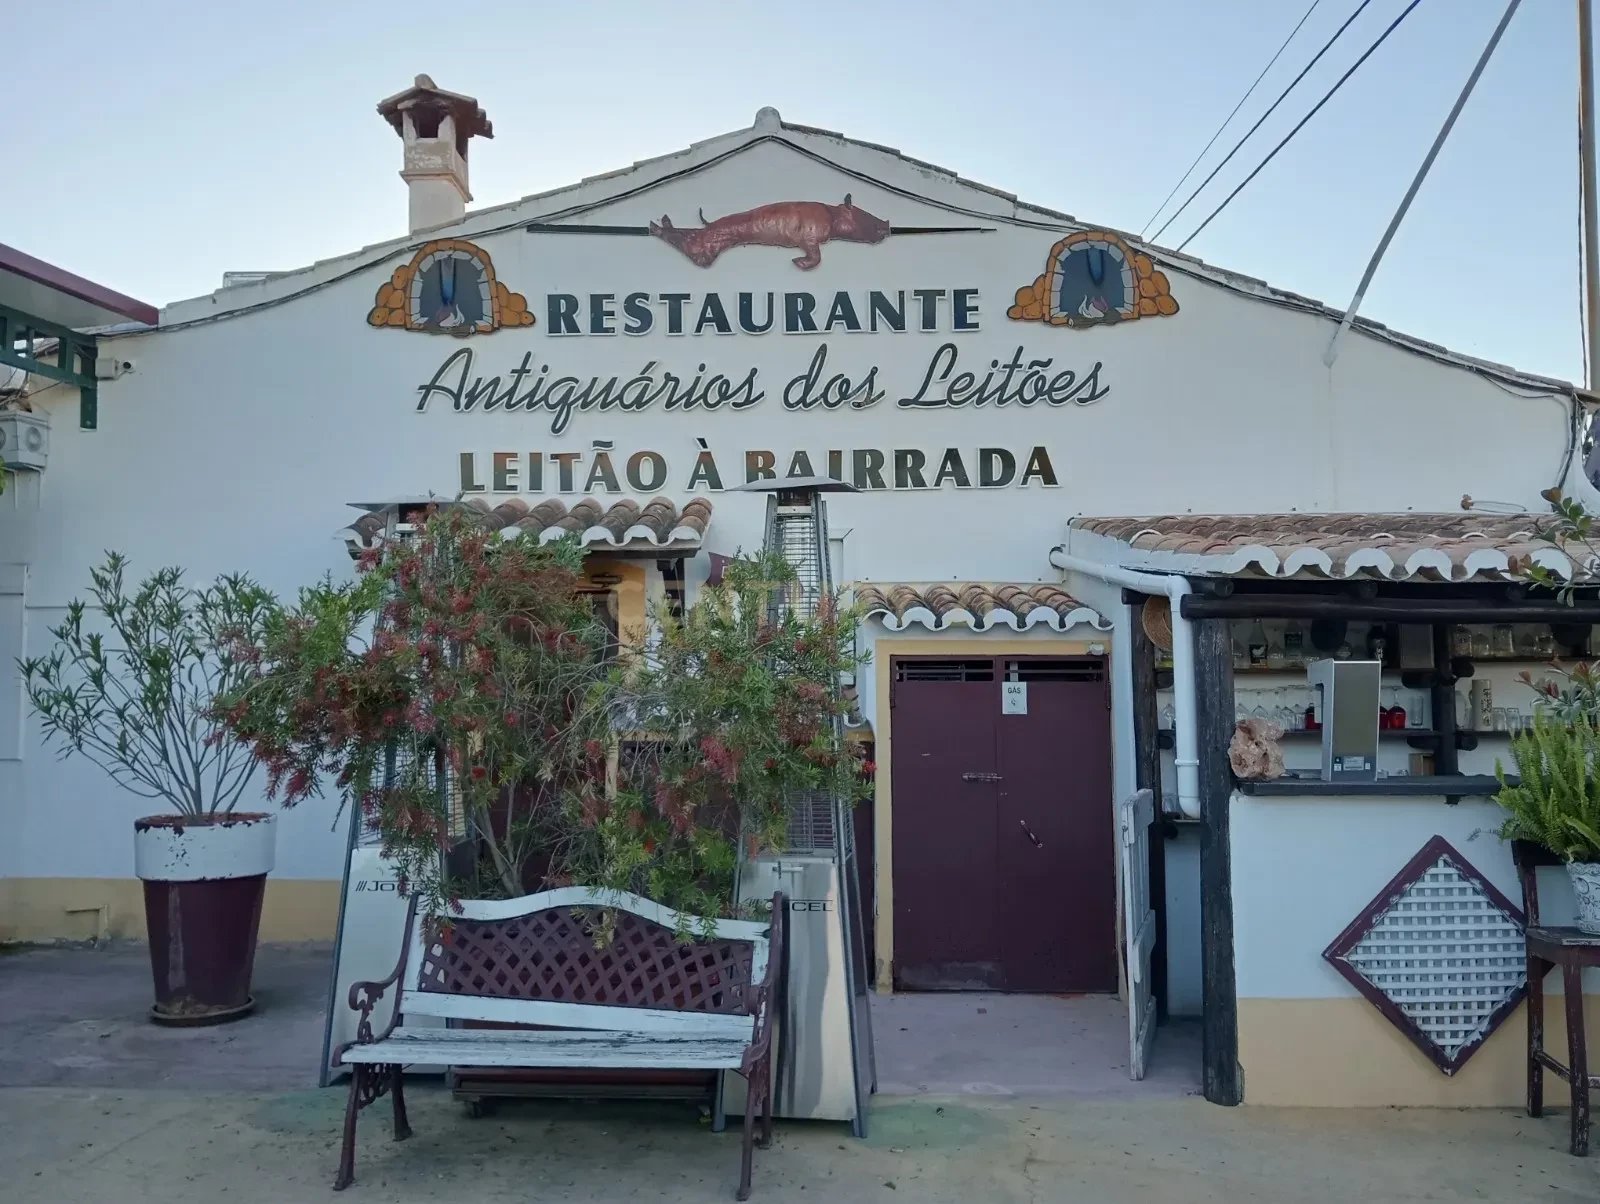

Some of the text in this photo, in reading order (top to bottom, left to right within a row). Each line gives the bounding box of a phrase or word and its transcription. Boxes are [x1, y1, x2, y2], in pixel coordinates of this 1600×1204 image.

[547, 289, 981, 336] RESTAURANTE
[416, 342, 1110, 435] Antiquários dos Leitões
[459, 437, 1061, 493] LEITÃO À BAIRRADA
